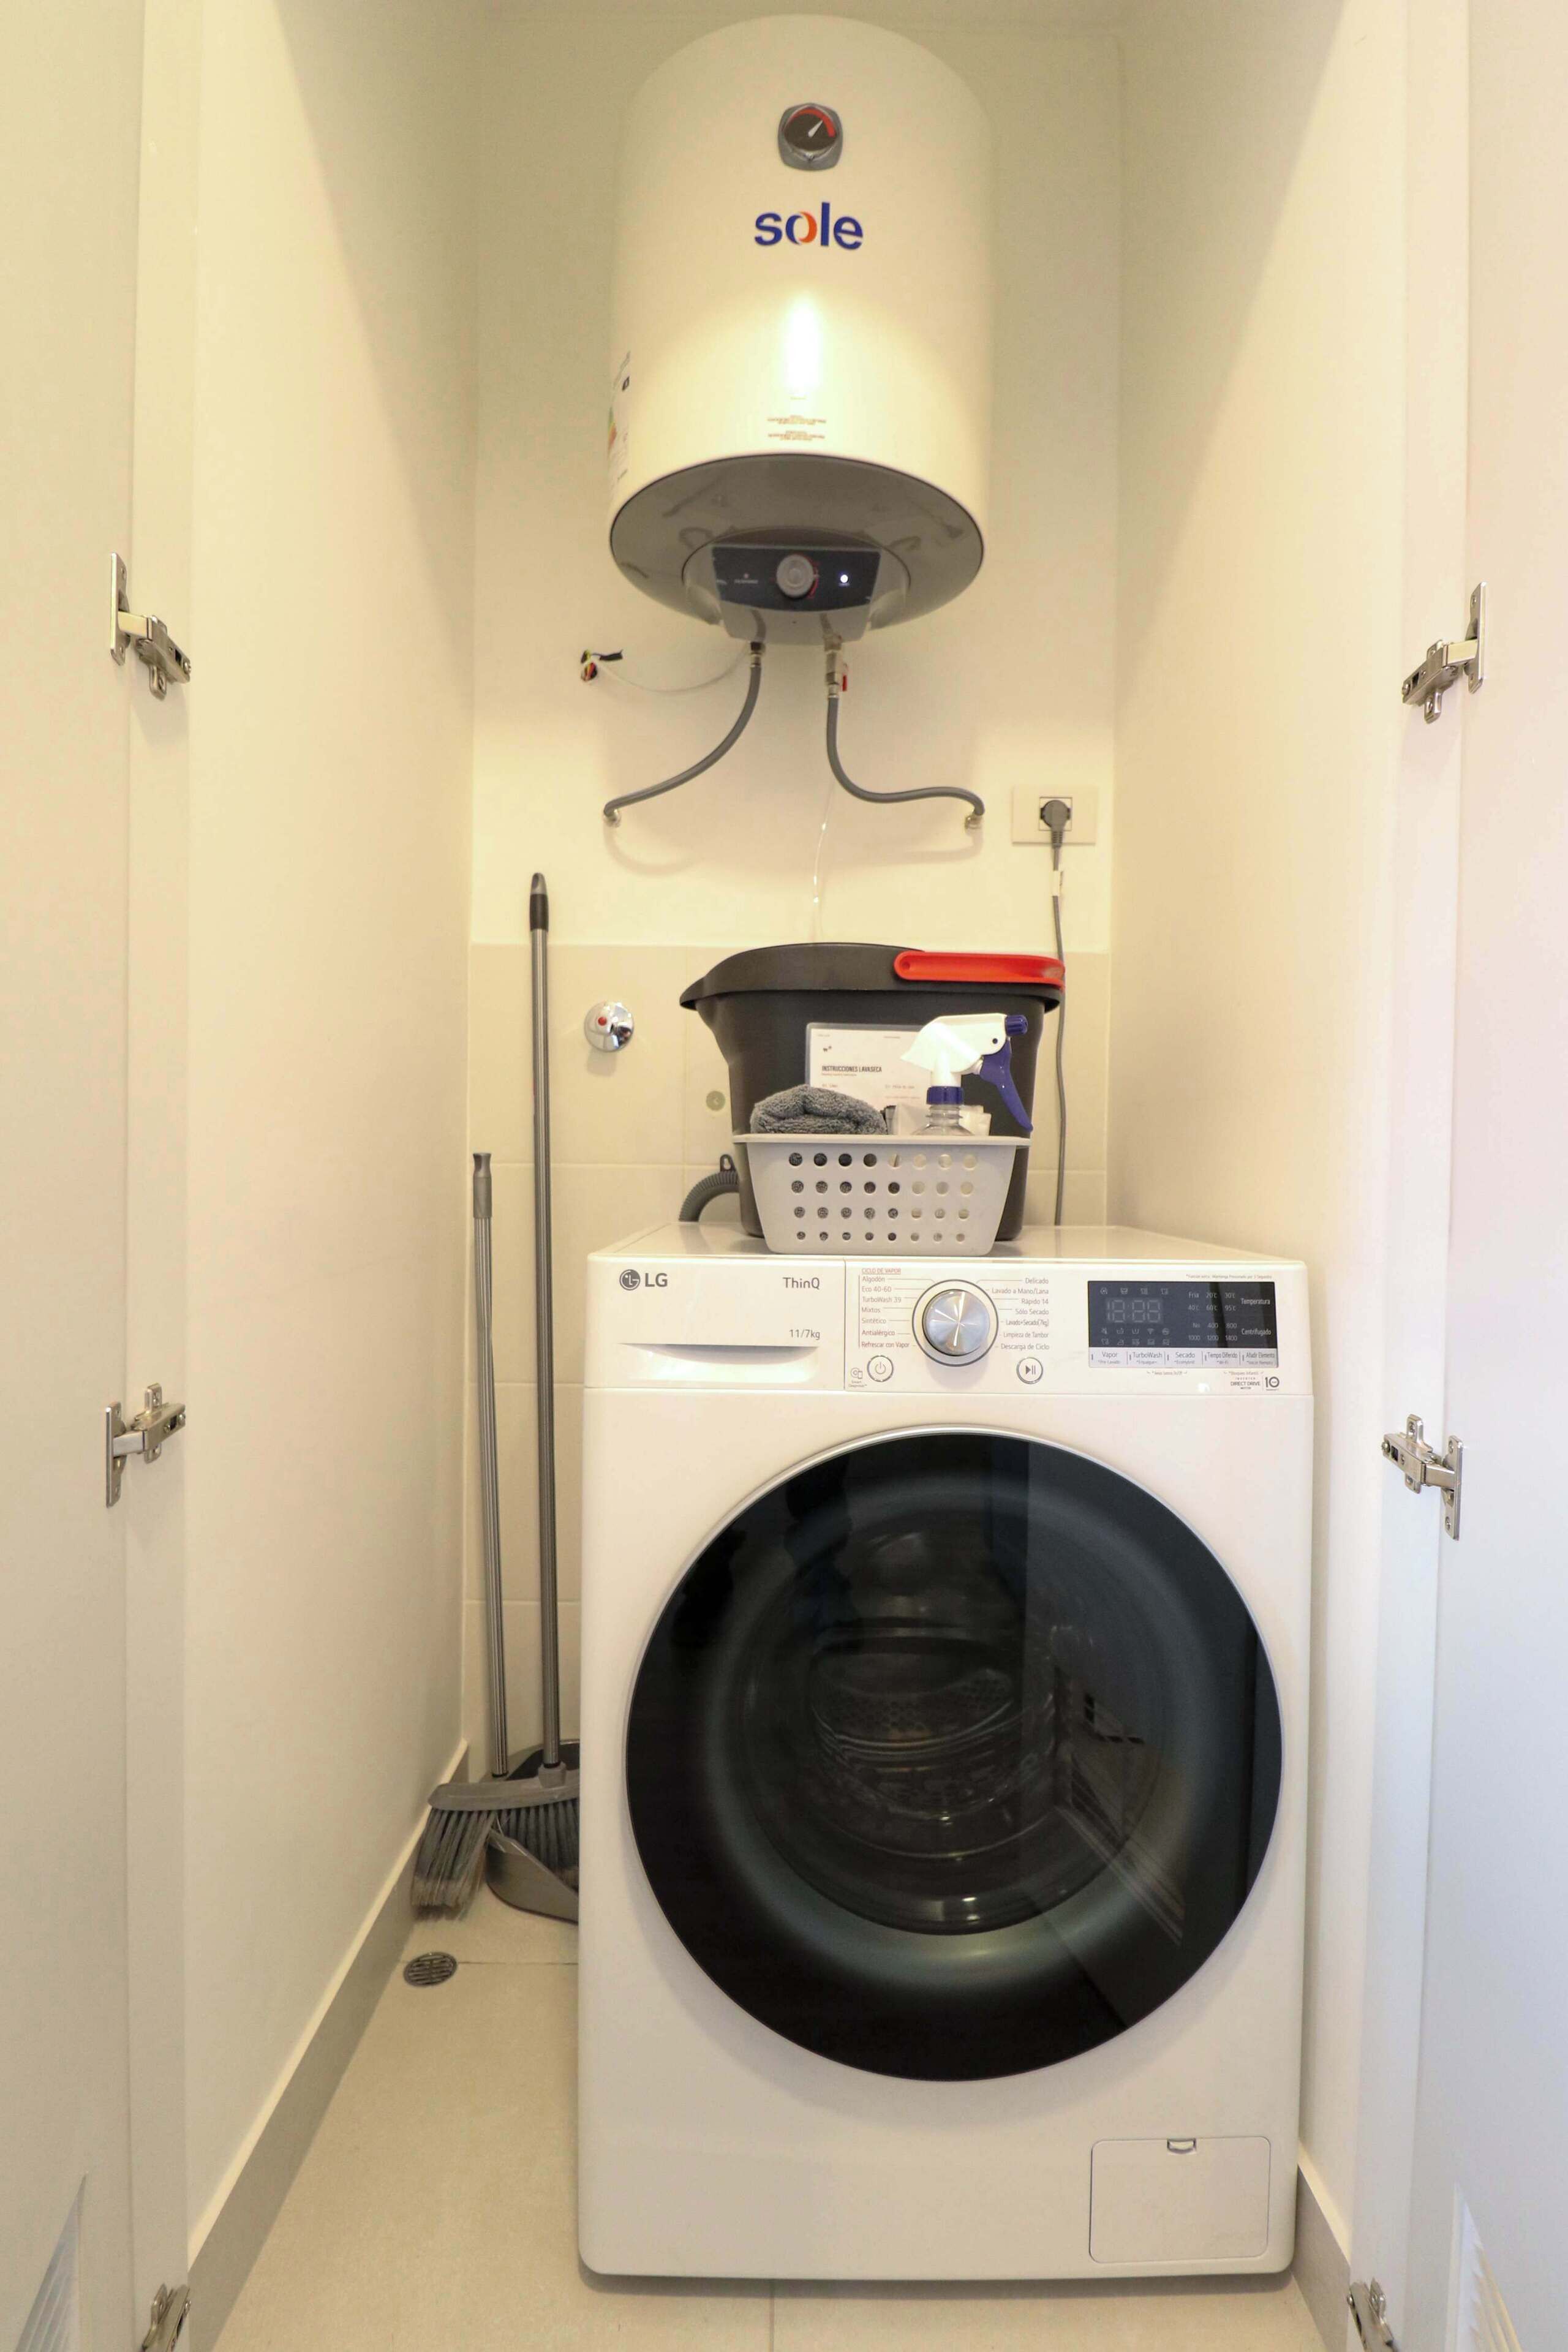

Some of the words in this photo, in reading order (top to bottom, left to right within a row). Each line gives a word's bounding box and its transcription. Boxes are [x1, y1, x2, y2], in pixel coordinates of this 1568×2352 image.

[754, 202, 864, 251] sole
[644, 1272, 668, 1287] LG
[783, 1277, 820, 1290] ThinQ
[1240, 1297, 1271, 1306] Temperatura
[789, 1329, 821, 1340] 11/7kg
[1241, 1327, 1272, 1336] Centrifugado
